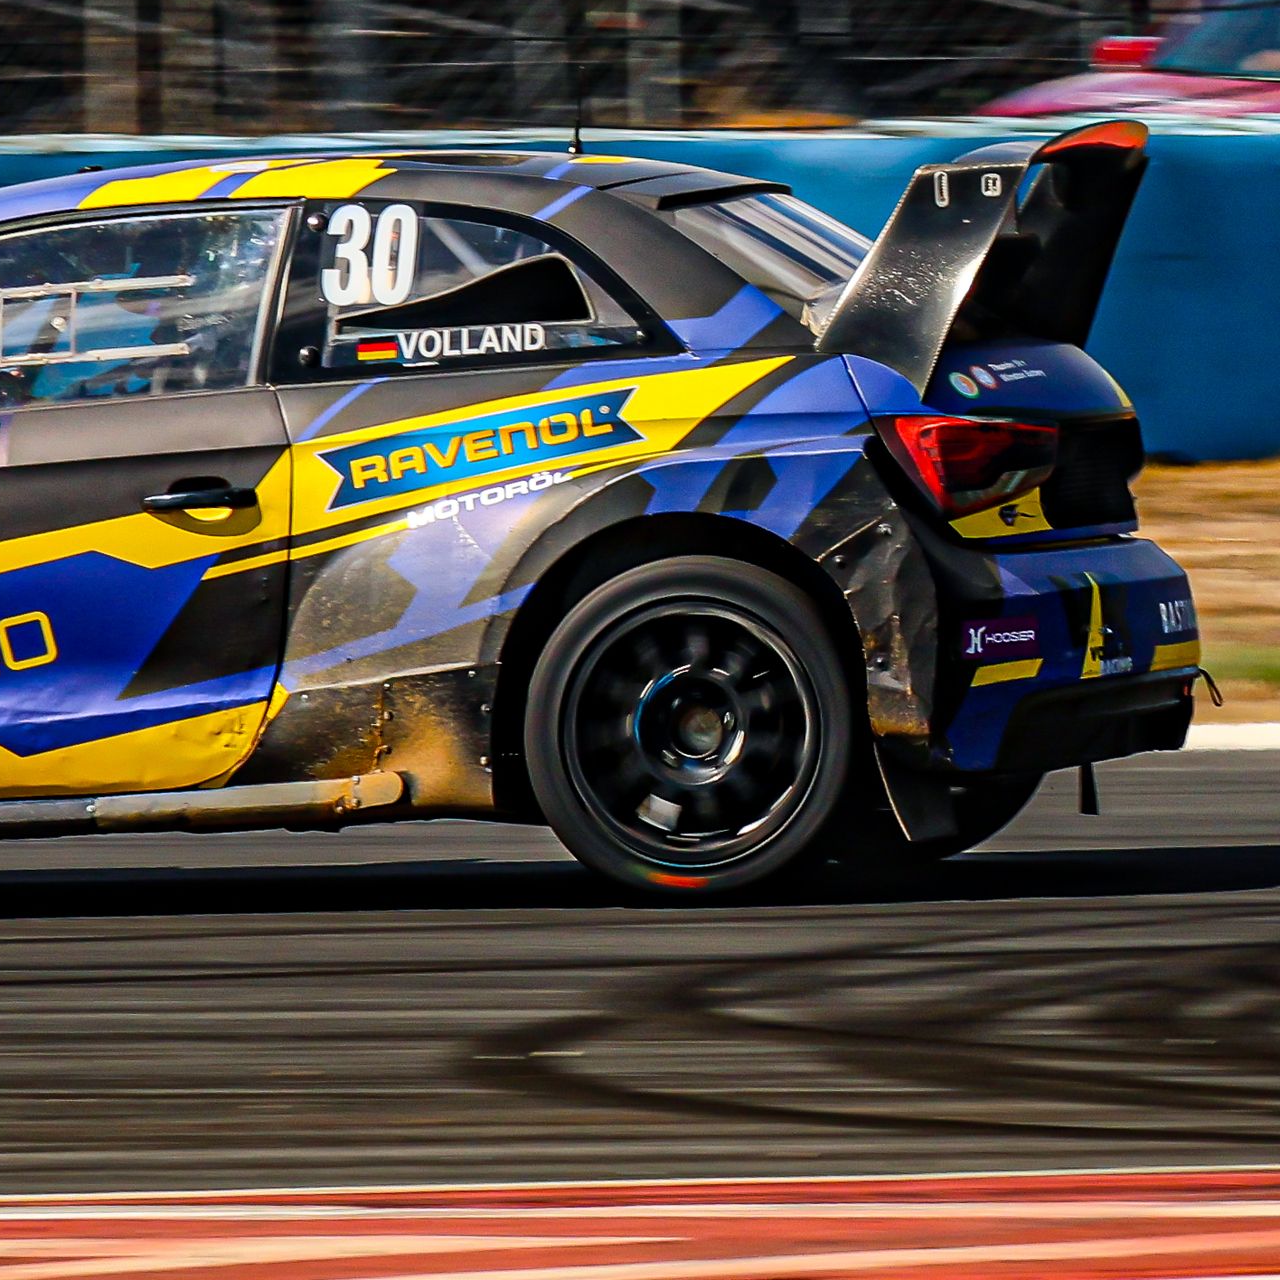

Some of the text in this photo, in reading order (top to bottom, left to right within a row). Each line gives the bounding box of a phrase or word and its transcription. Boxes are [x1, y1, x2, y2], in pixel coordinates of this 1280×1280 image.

[322, 204, 419, 307] 30
[396, 322, 546, 360] VOLLAND
[349, 407, 615, 489] RAVENOL
